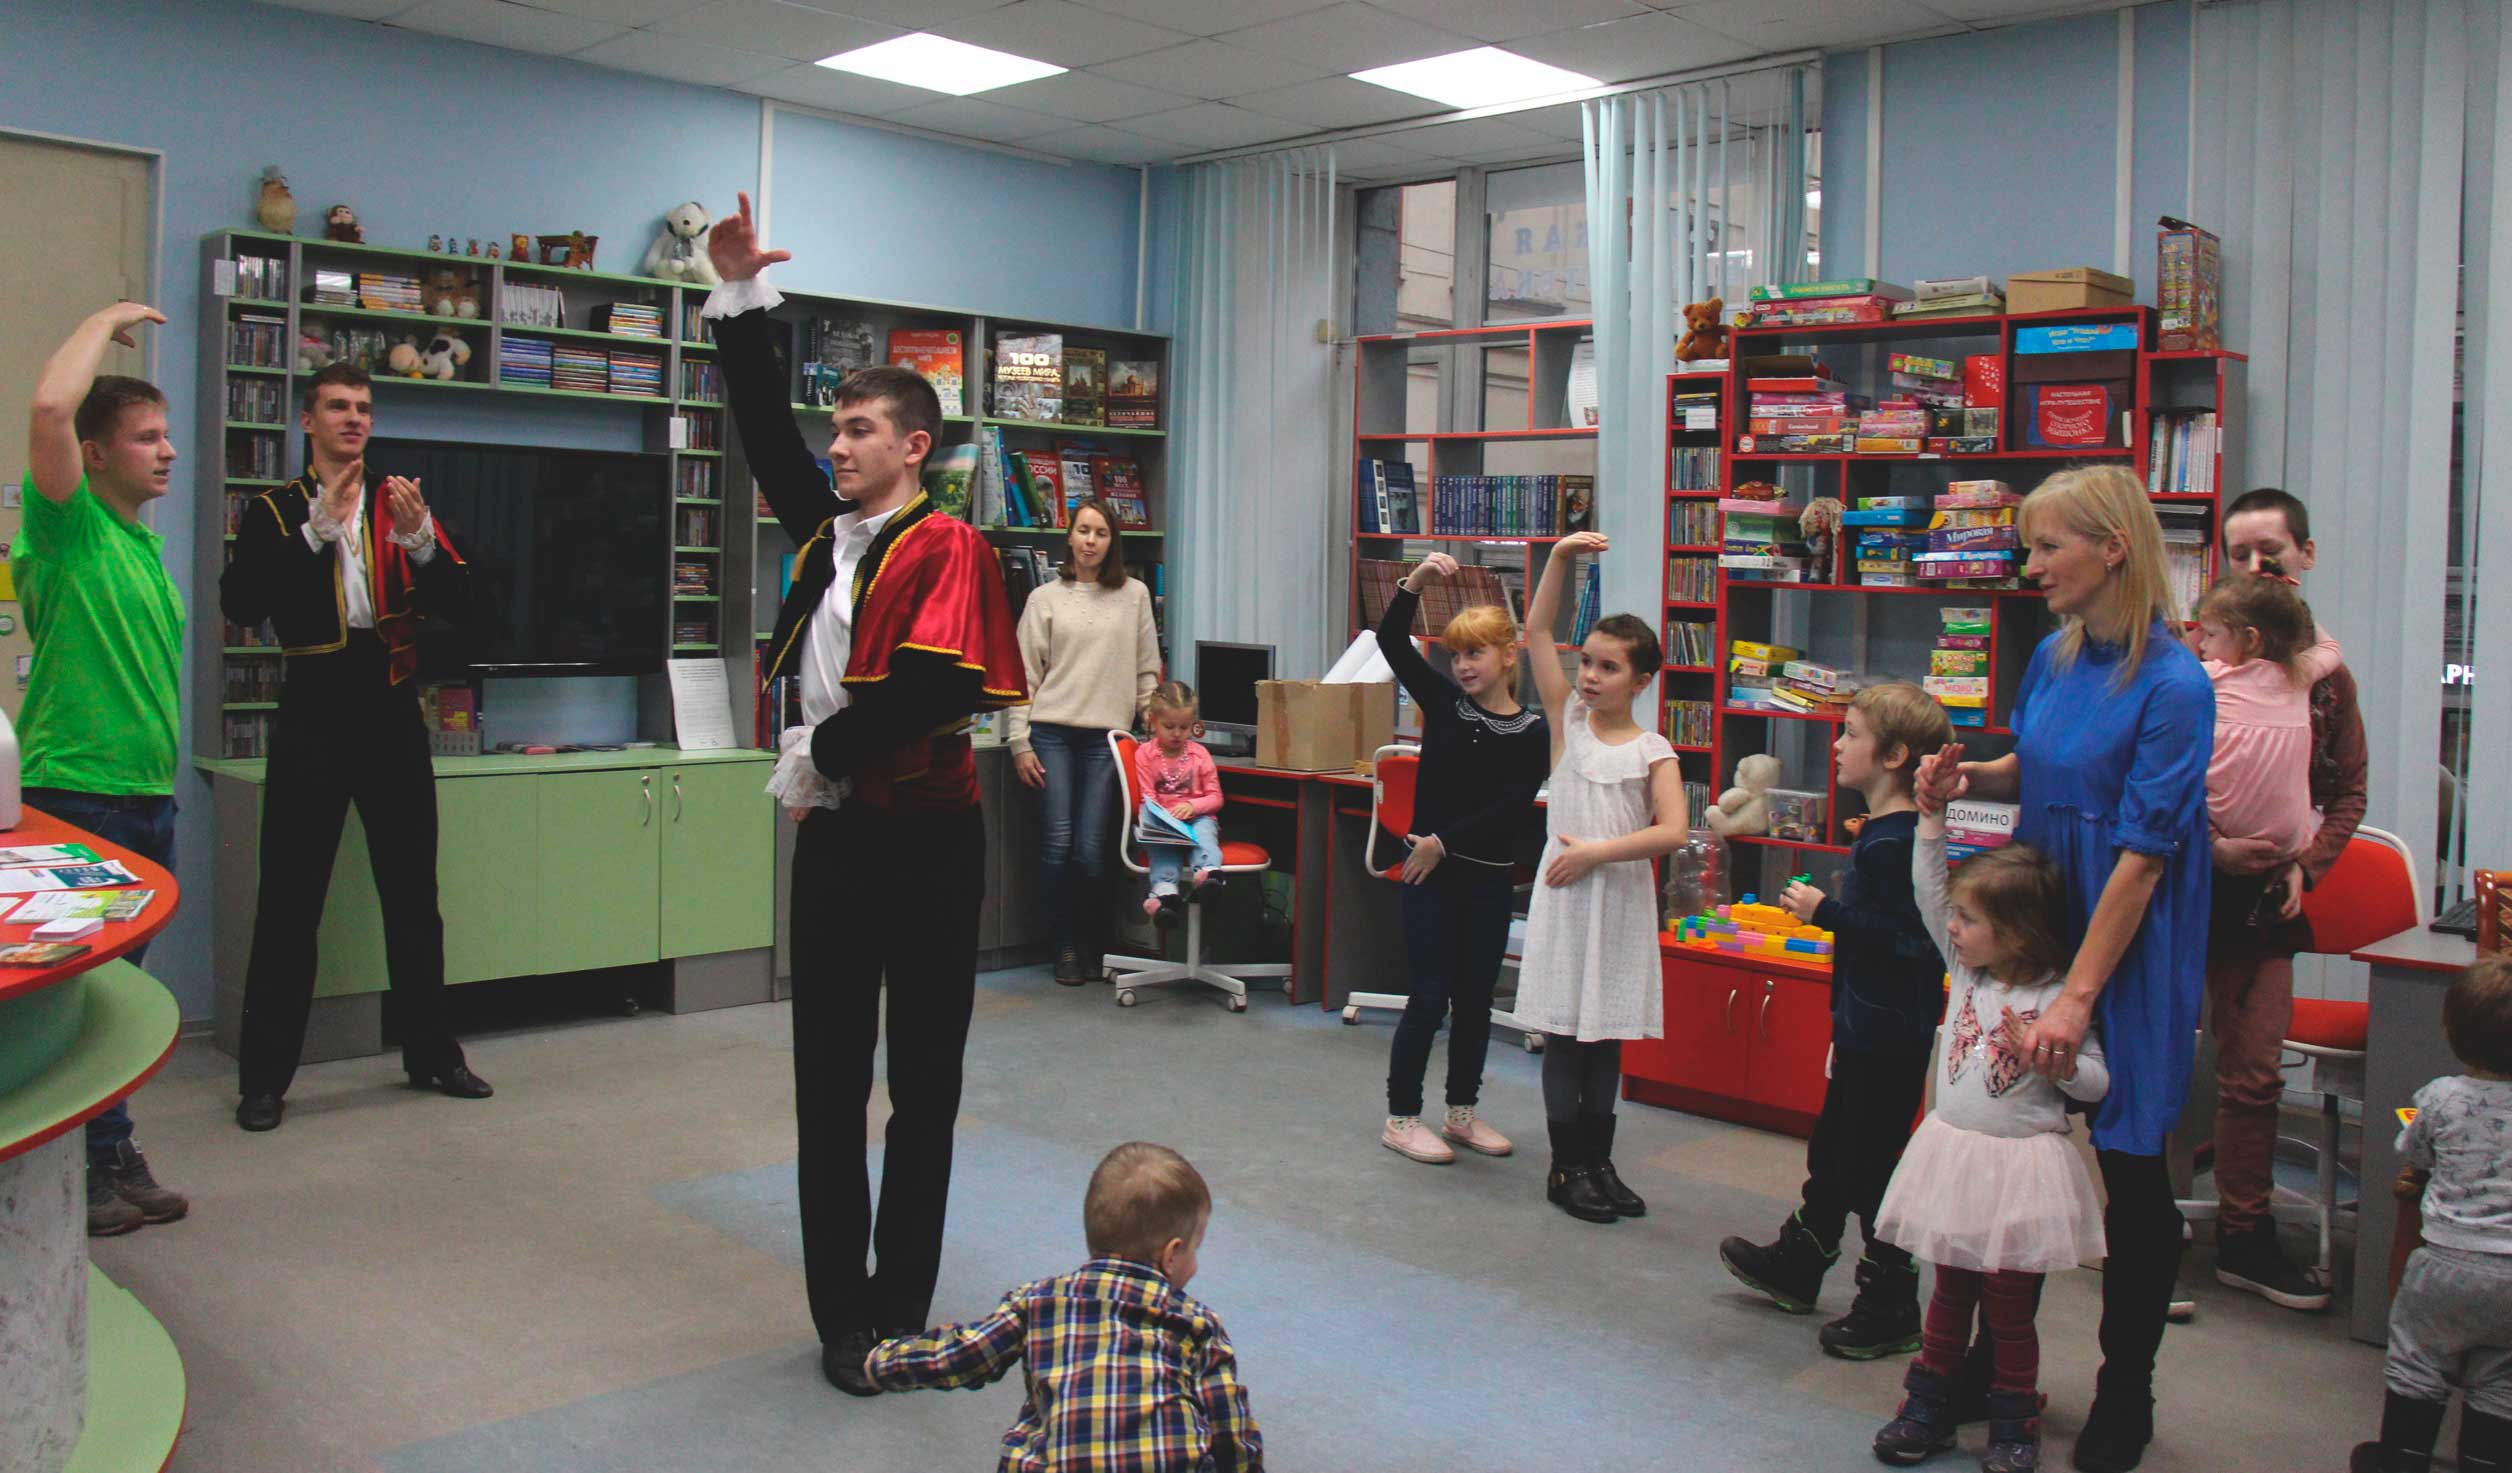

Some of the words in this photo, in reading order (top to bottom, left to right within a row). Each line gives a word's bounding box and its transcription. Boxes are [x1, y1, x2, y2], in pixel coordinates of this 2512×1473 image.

[1009, 352, 1049, 366] 100
[998, 366, 1031, 376] МУЗЕЕВ
[1946, 527, 1993, 544] Мировая
[1945, 808, 2009, 826] ДОМИНО
